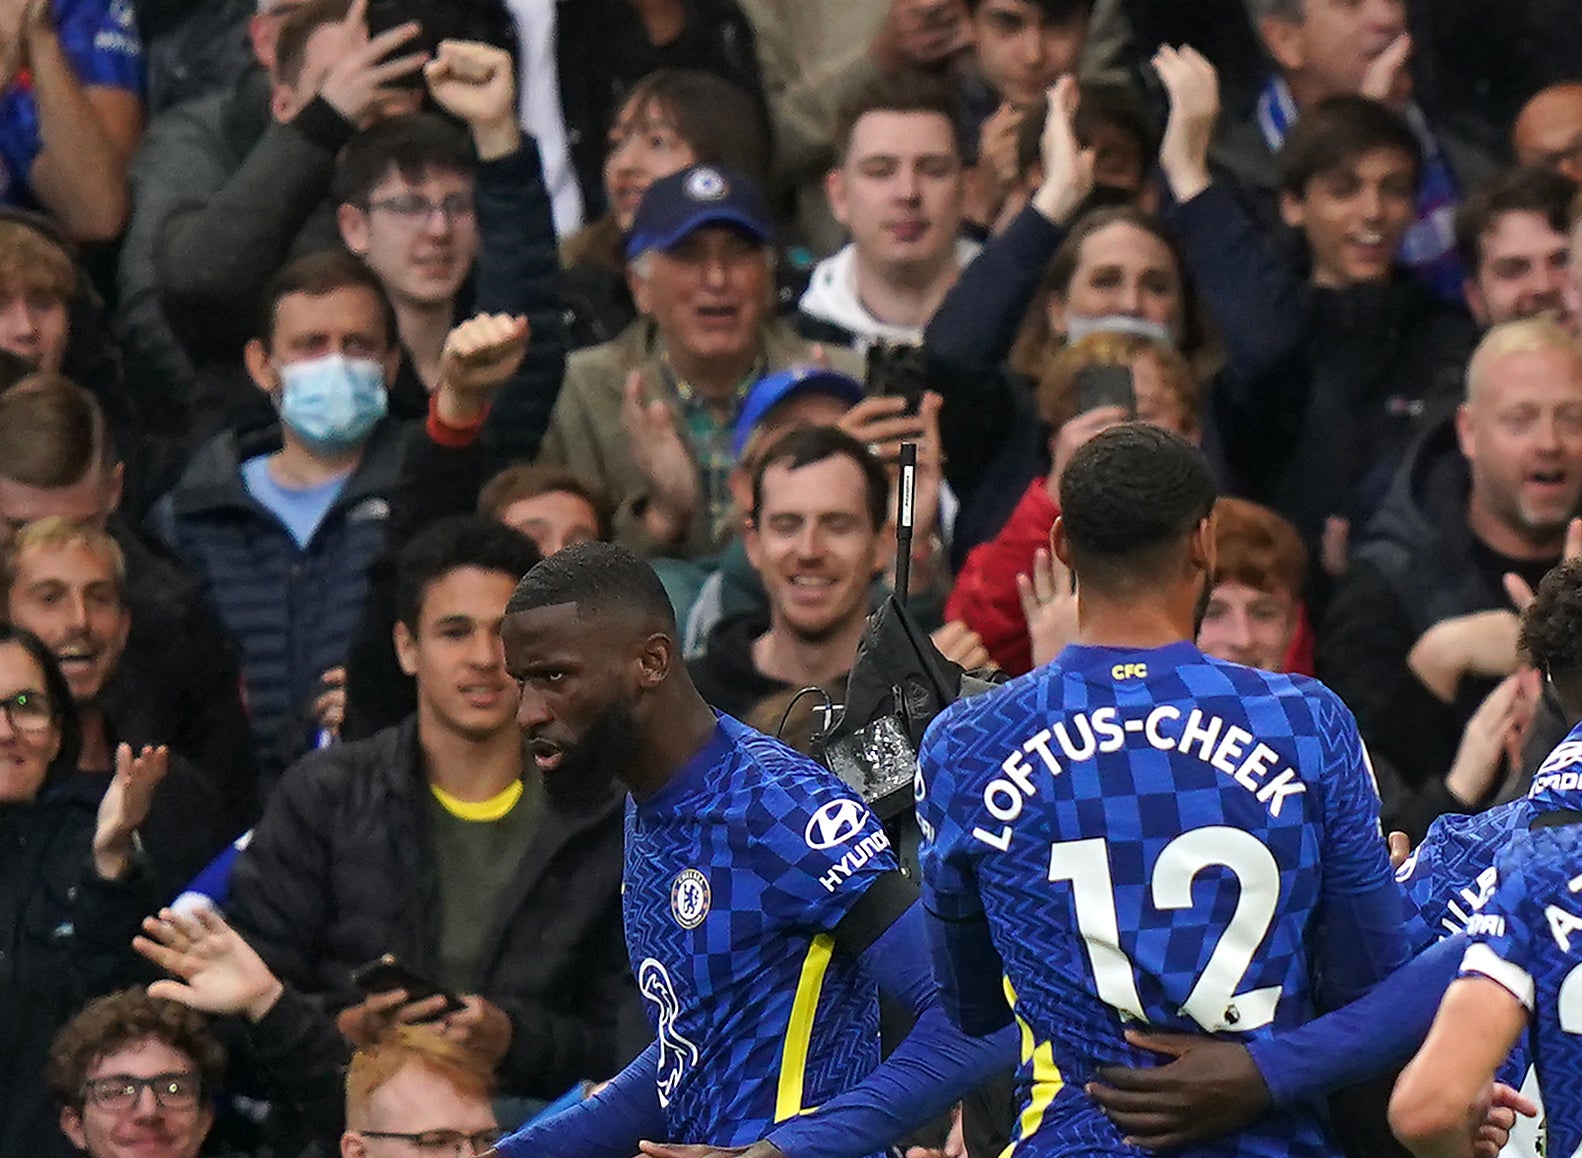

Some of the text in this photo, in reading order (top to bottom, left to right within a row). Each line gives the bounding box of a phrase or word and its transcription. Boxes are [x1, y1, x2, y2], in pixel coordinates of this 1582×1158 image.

[1111, 662, 1148, 681] CFC
[972, 705, 1307, 853] LOFTUS-CHEEK
[1048, 824, 1284, 1034] 12
